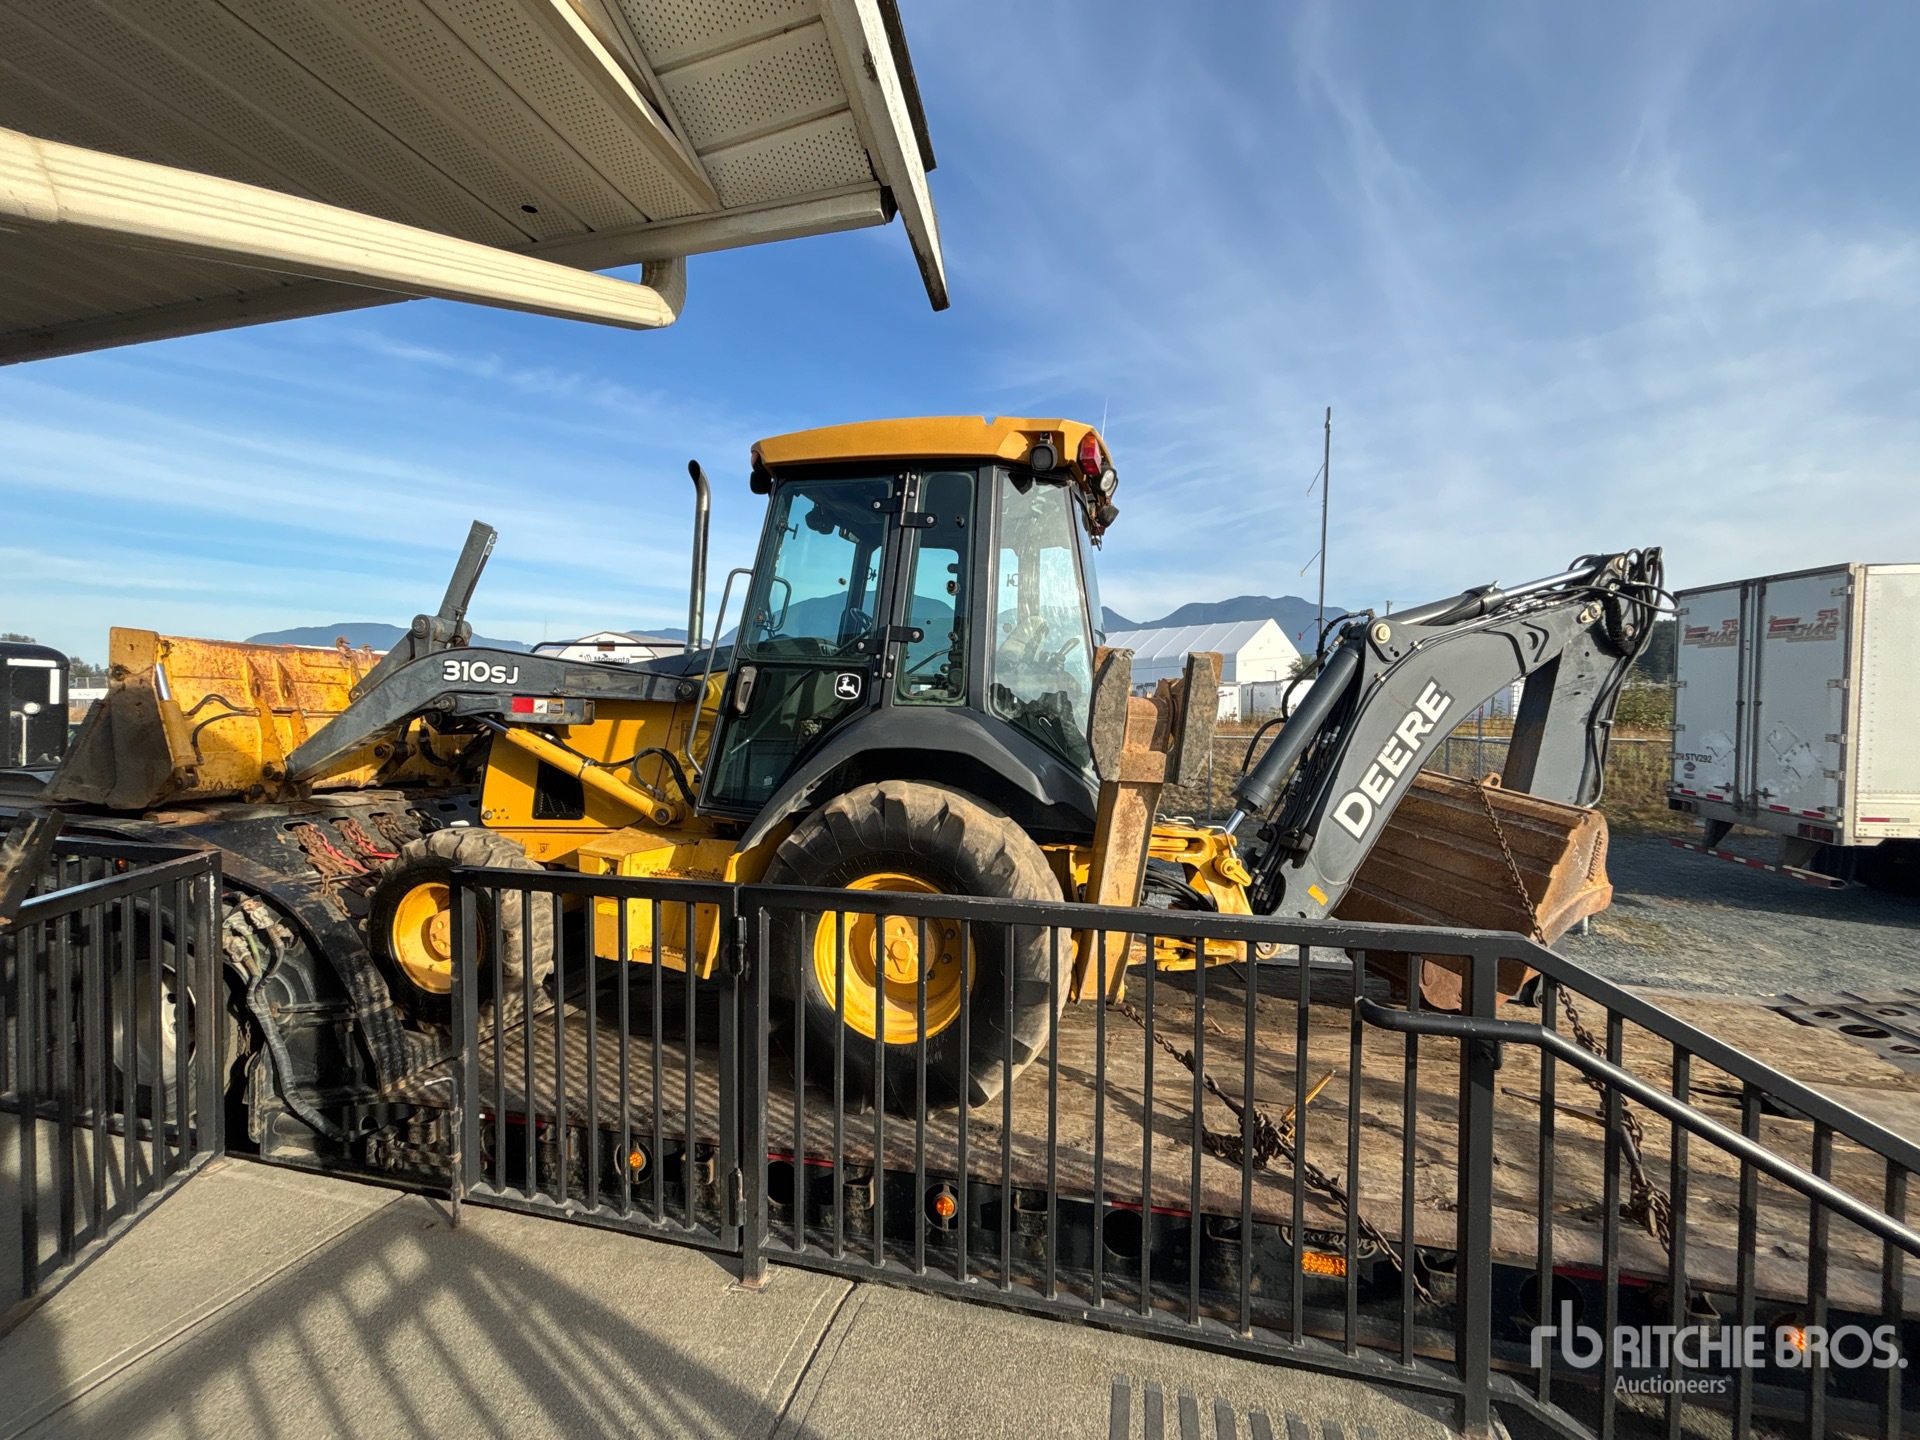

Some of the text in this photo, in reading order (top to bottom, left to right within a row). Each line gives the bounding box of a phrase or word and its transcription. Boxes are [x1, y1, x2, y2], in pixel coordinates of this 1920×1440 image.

[443, 660, 519, 684] 310SJ
[1331, 680, 1453, 841] DEERE
[1685, 752, 1713, 763] STV292
